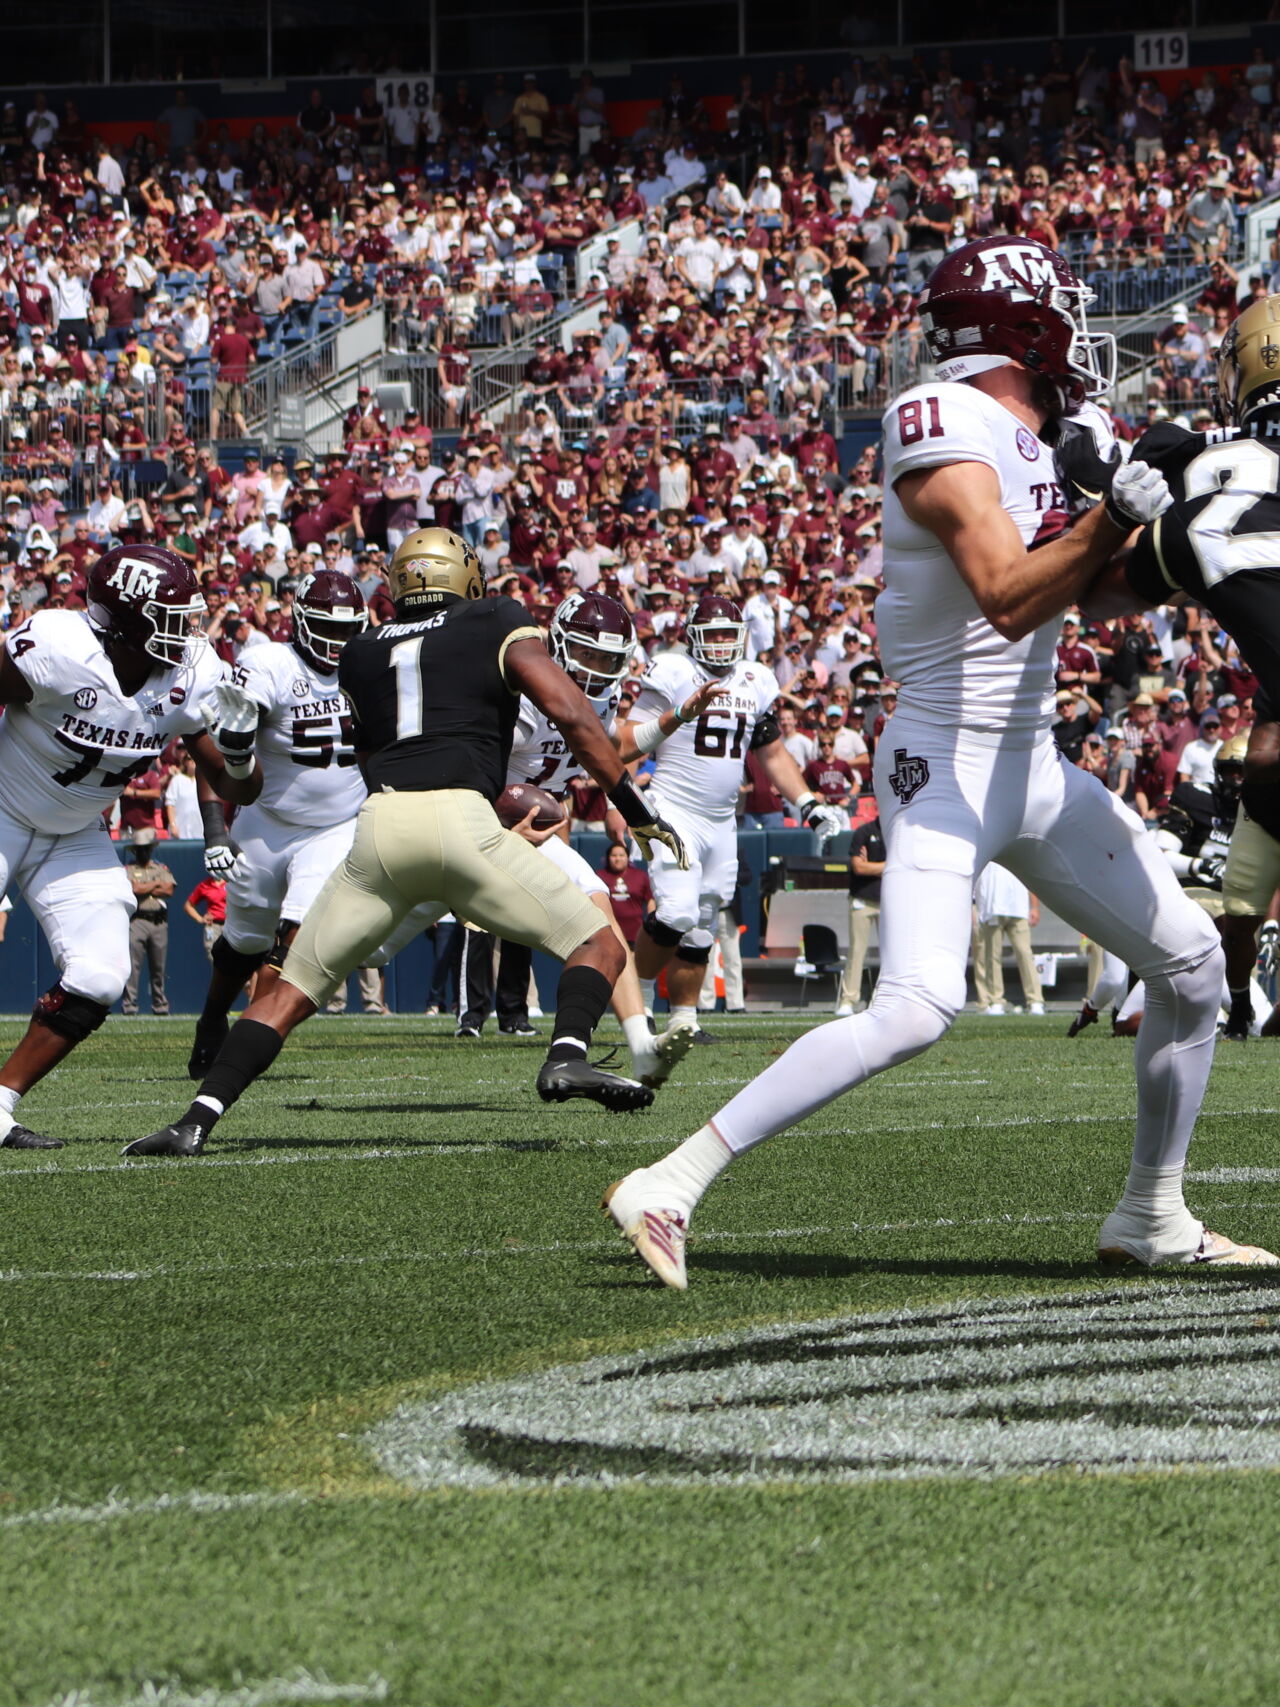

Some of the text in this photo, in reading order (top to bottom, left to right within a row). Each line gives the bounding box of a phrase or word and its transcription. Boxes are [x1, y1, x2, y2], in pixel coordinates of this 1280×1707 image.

[1141, 36, 1184, 66] 119
[383, 82, 430, 109] 18
[897, 396, 945, 447] 81
[404, 593, 444, 606] COLORADO
[377, 610, 448, 640] THOMAS
[76, 690, 97, 708] SEC
[388, 636, 424, 740] 1
[291, 700, 341, 719] TEXAS
[63, 713, 168, 750] TEXAS A&M
[695, 710, 748, 758] 61
